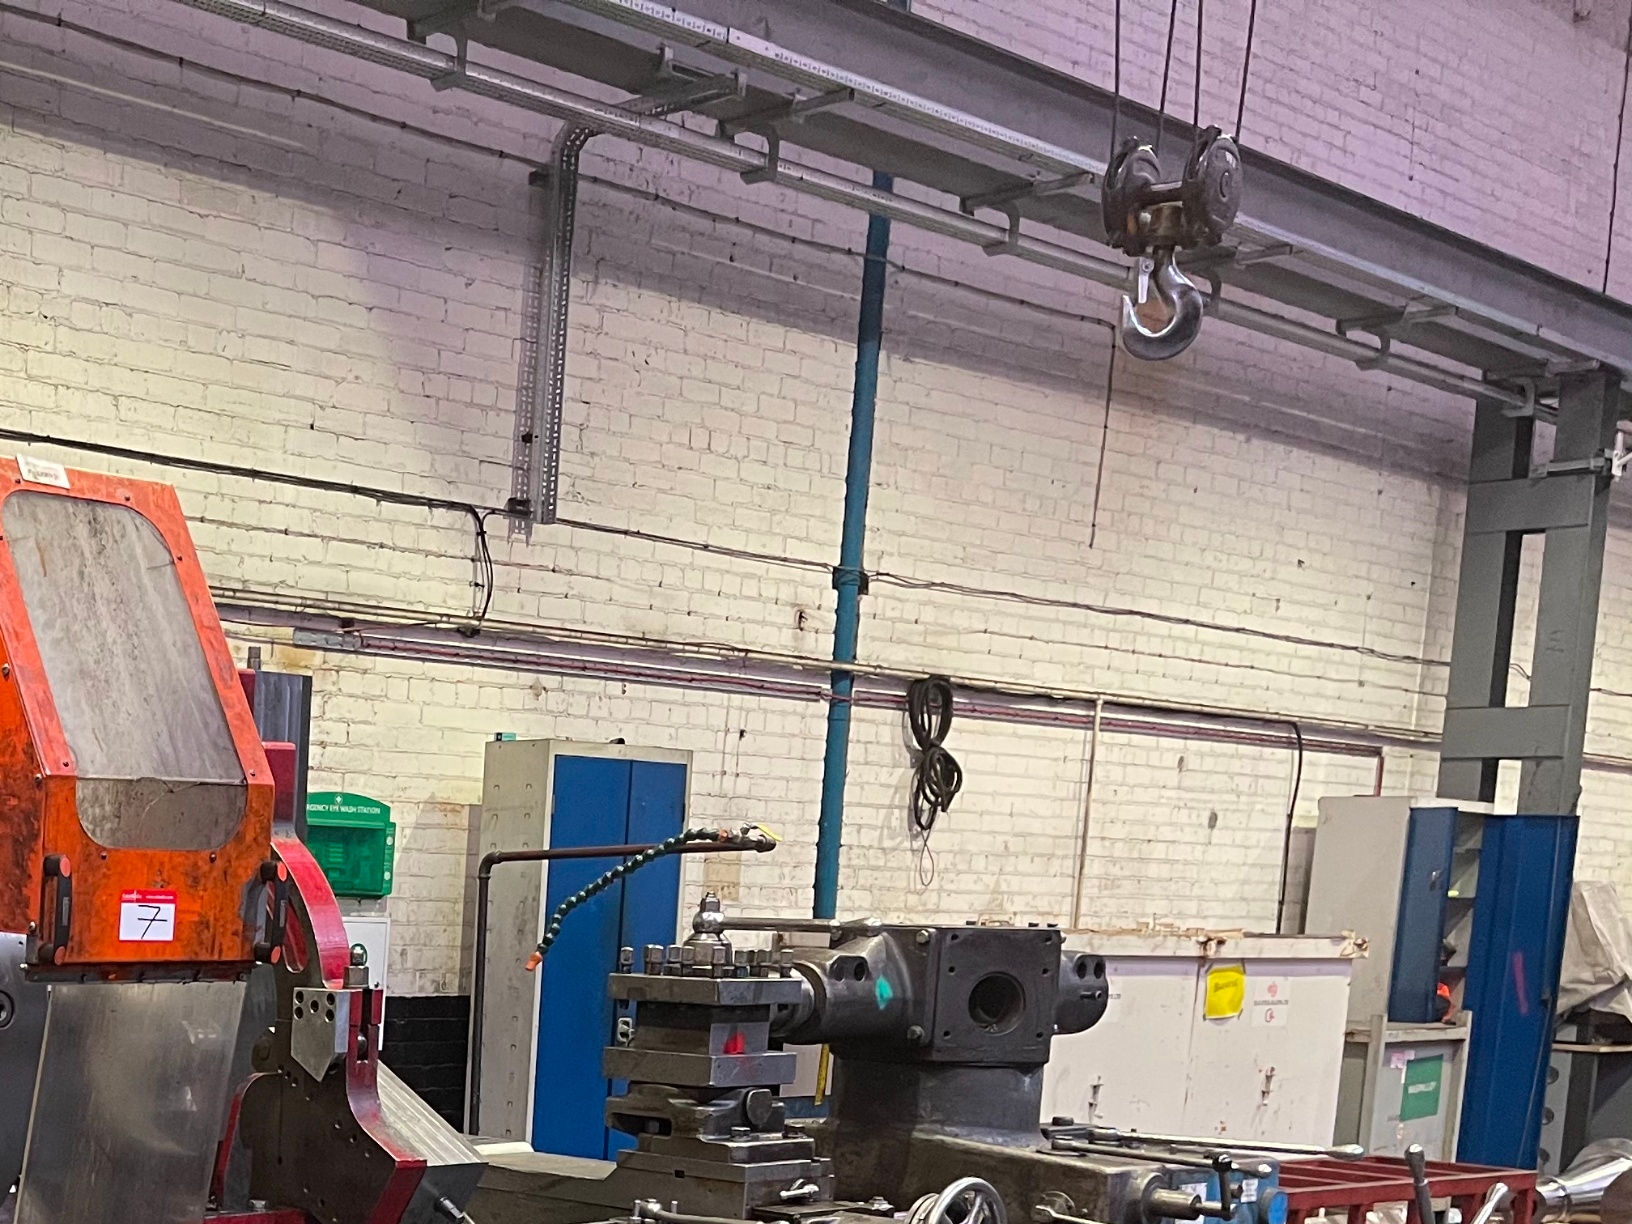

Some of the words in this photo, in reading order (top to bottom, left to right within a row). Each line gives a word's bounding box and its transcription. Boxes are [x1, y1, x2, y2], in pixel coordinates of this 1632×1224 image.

[329, 804, 340, 813] EYE
[340, 805, 357, 814] WASH
[357, 806, 381, 815] STATION
[137, 904, 168, 940] 7
